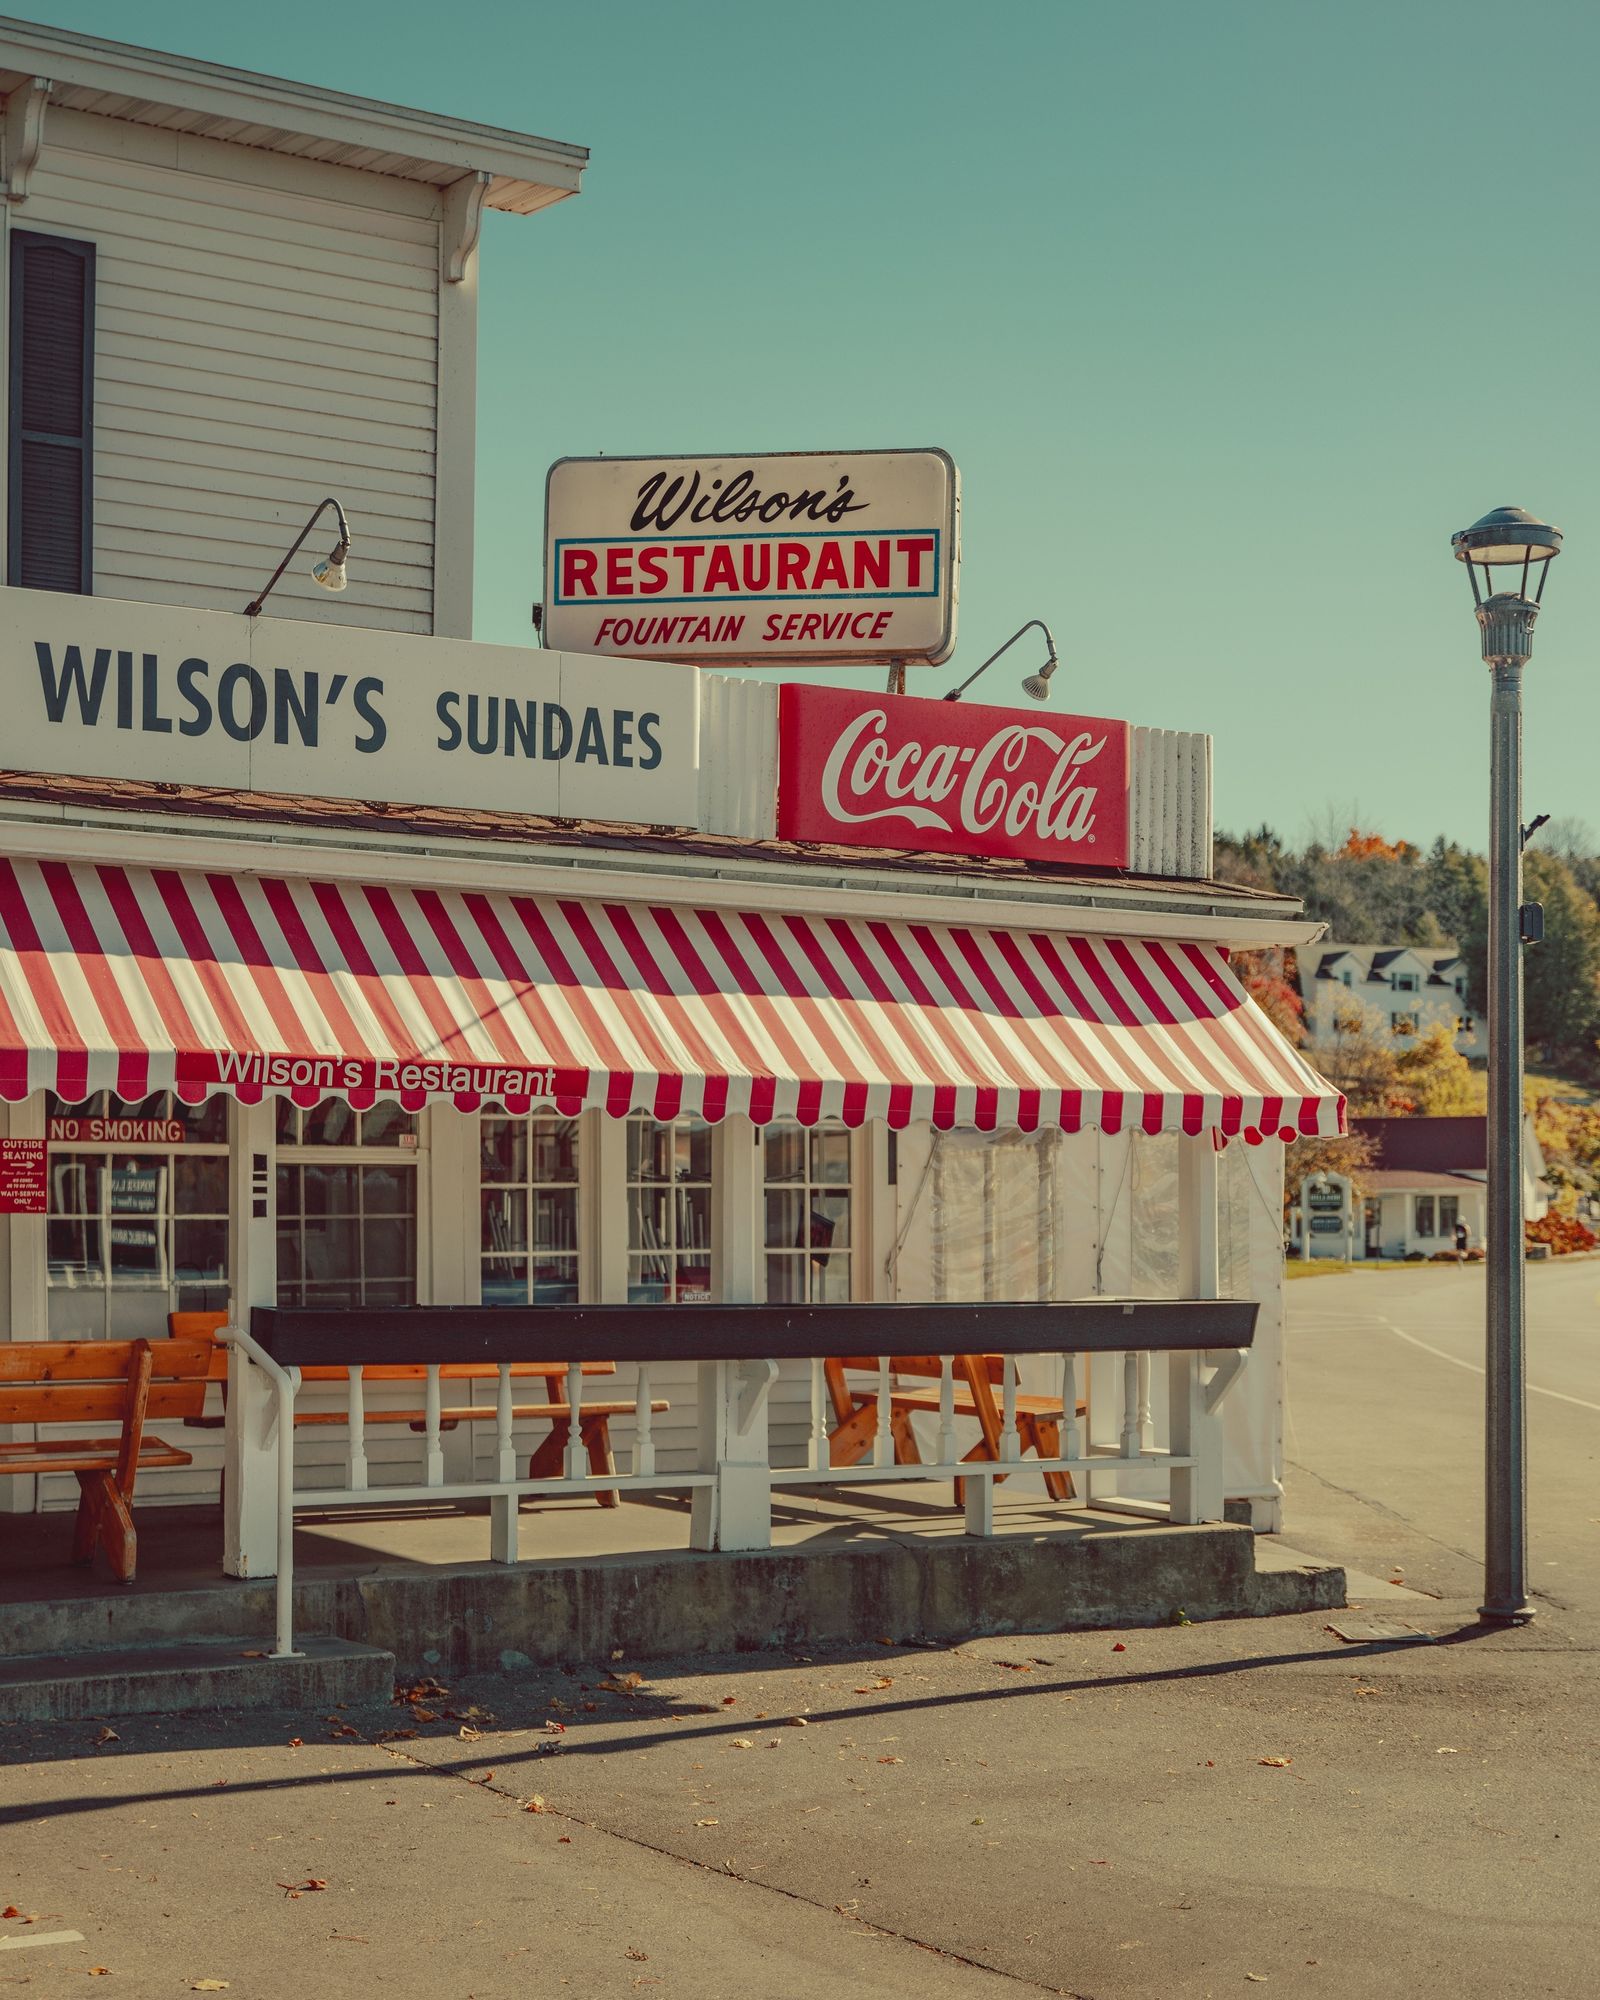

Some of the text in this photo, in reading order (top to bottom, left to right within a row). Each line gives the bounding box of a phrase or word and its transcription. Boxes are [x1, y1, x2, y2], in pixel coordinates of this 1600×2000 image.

[630, 470, 871, 532] Wilson's
[562, 538, 934, 597] RESTAURANT
[594, 611, 894, 647] FOUNTAIN SERVICE
[34, 641, 663, 770] WILSON'S SUNDAES
[821, 709, 1108, 843] Coca-Cola
[214, 1050, 557, 1097] Wilson's Restaurant
[2, 1140, 44, 1149] OUTSIDE
[51, 1119, 181, 1141] NO SMOKING
[2, 1151, 44, 1160] SEATING
[684, 1293, 710, 1301] NOTICE
